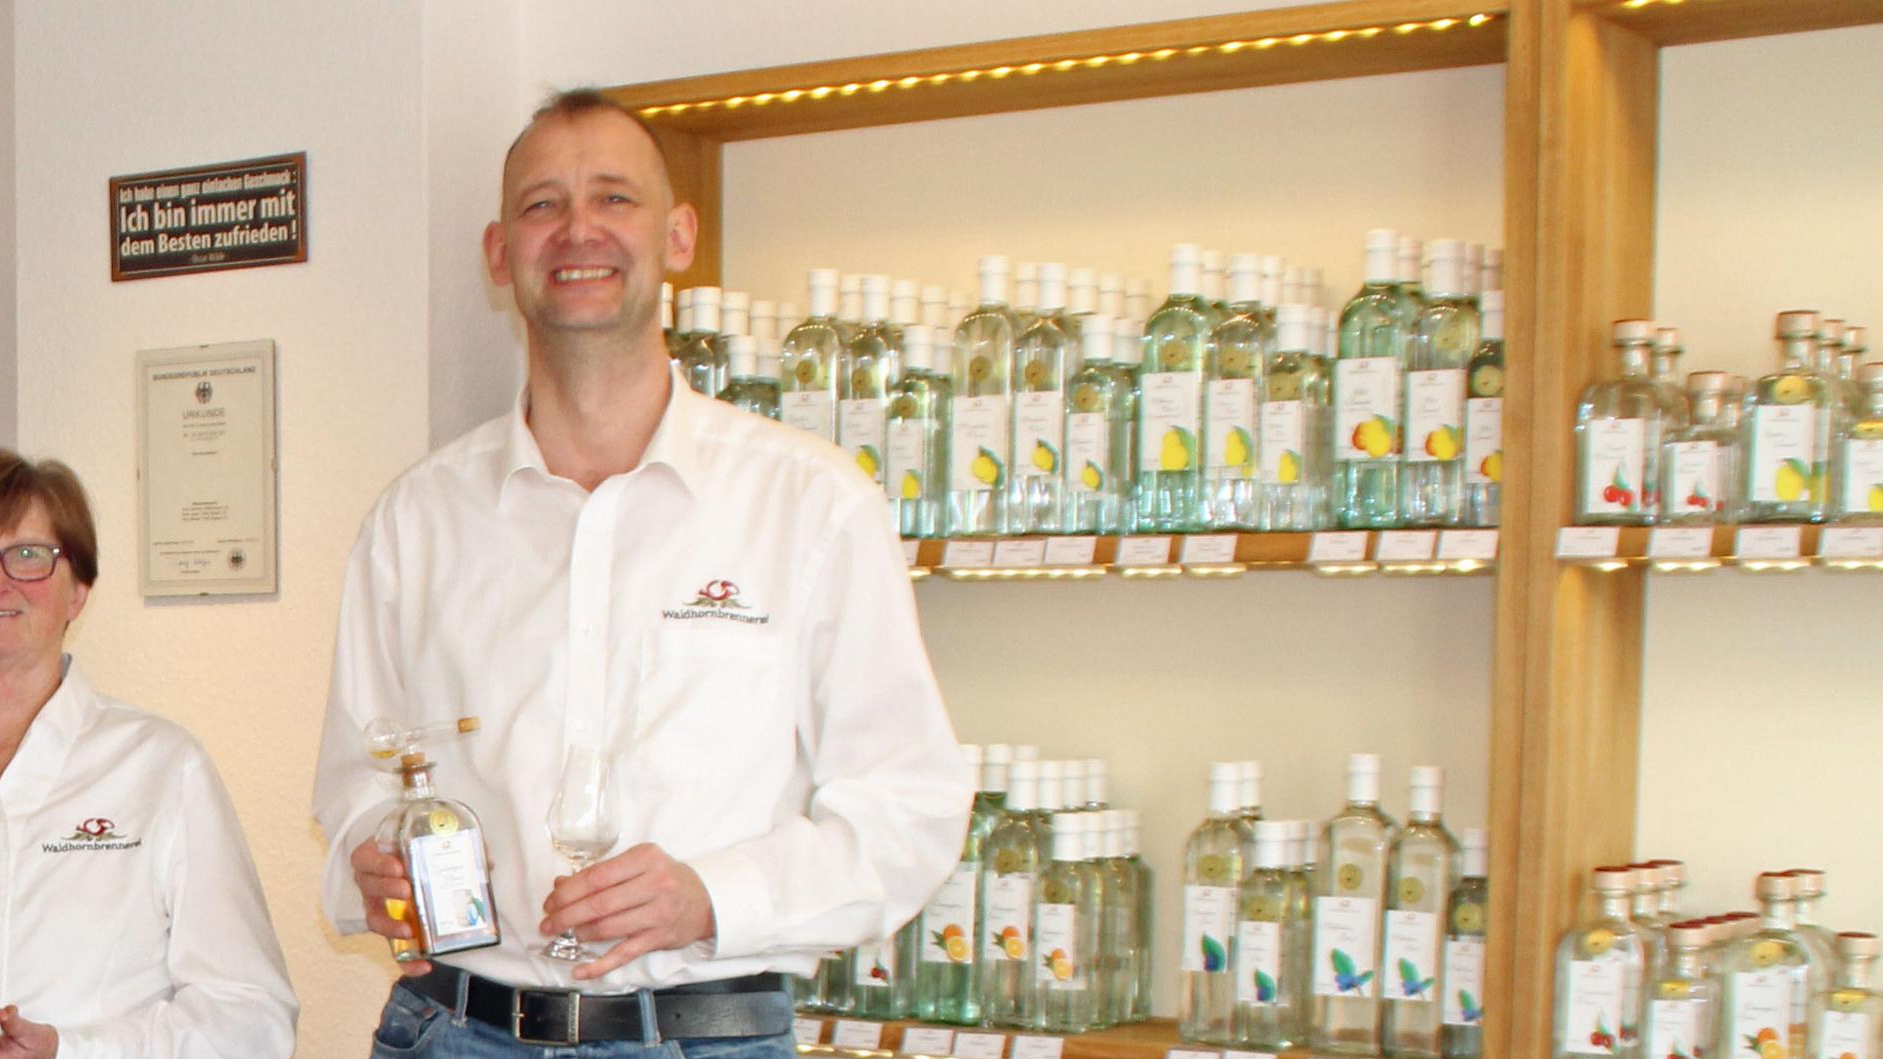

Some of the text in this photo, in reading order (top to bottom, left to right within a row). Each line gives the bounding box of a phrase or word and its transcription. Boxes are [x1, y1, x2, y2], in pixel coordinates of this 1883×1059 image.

[120, 188, 296, 233] Ich bin immer mit
[121, 236, 155, 257] dem
[158, 232, 212, 254] Besten
[214, 221, 288, 248] zufrieden
[662, 608, 770, 625] Waldhornbrennerei
[41, 837, 142, 853] Waldhornbrennerei
